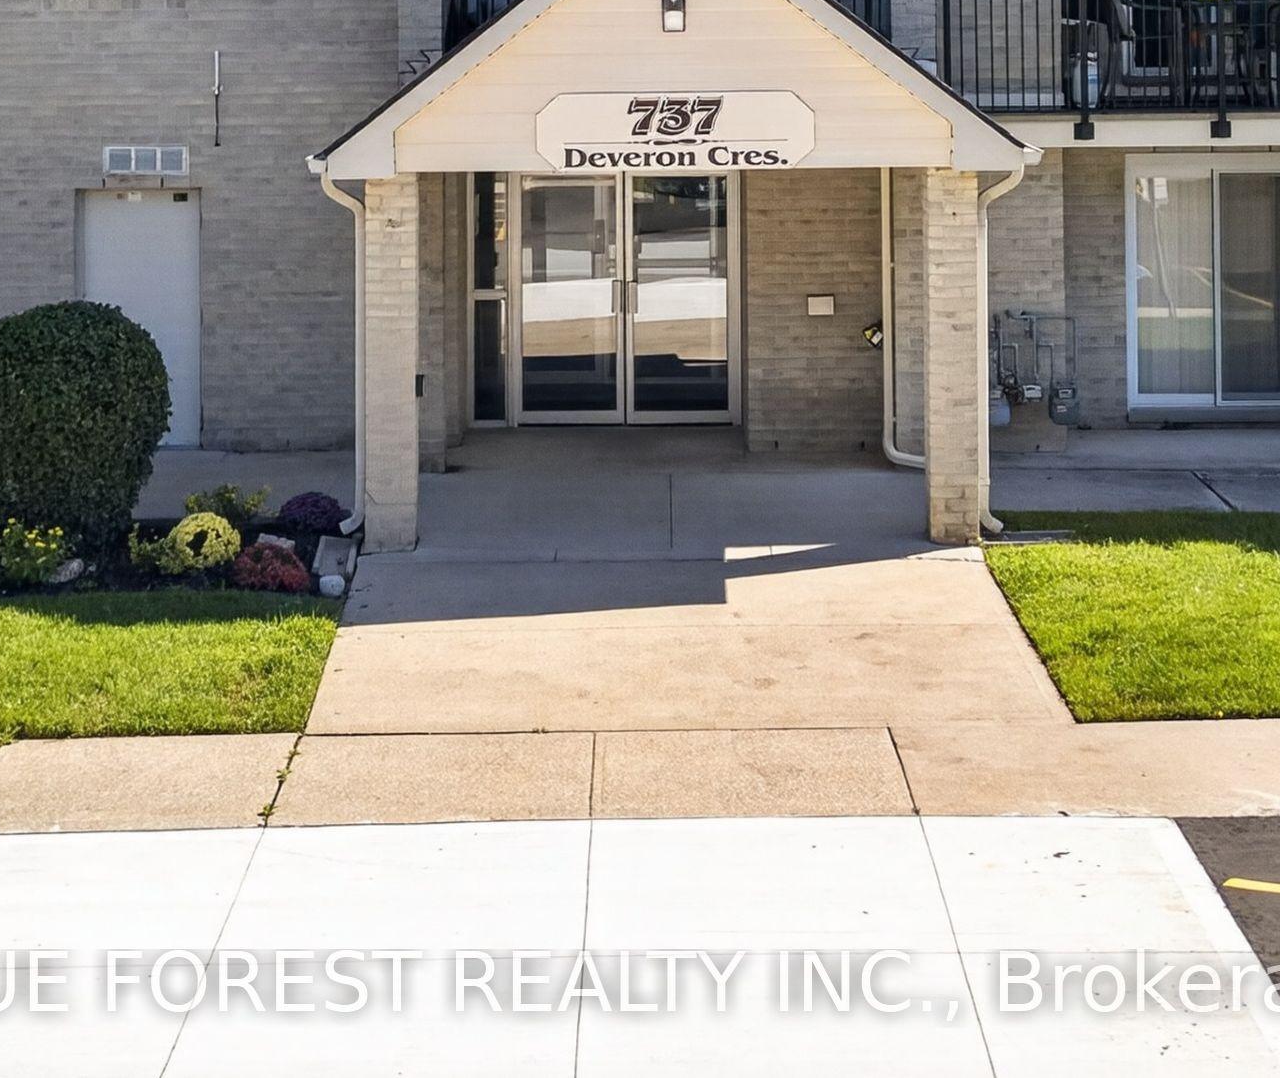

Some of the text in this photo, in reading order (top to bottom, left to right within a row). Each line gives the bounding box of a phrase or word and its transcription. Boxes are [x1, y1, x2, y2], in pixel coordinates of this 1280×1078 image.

[627, 95, 724, 136] 737
[564, 146, 789, 168] Deveron Cres.
